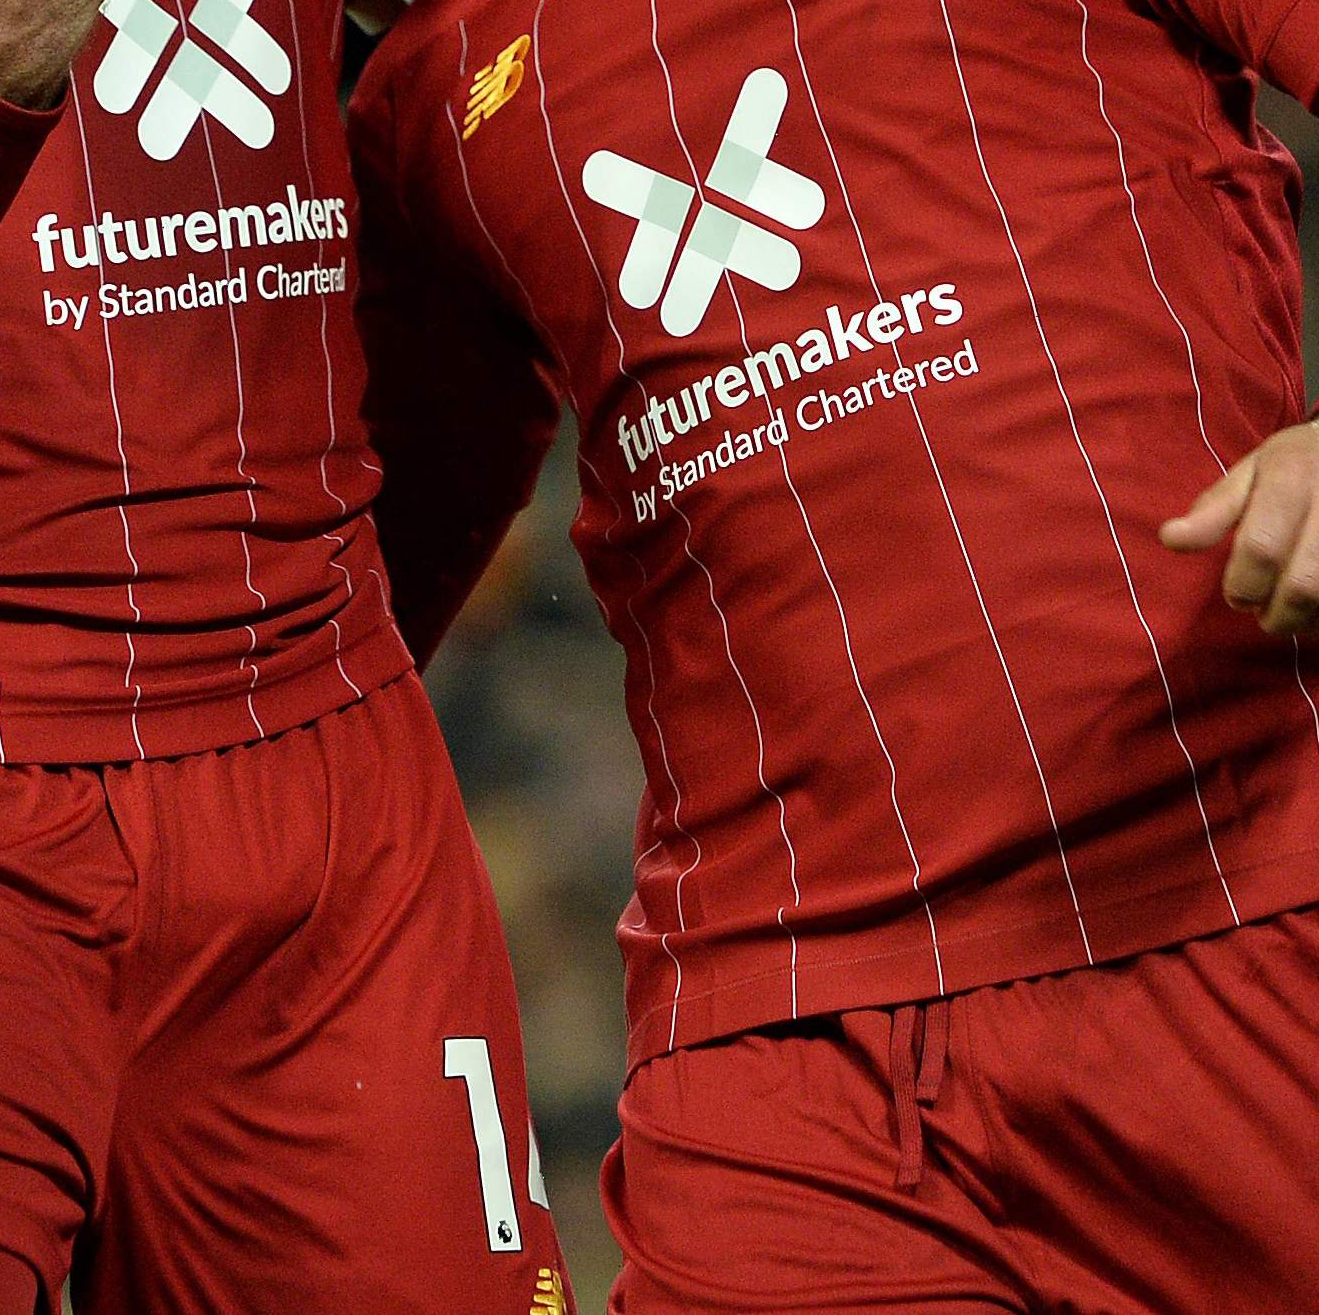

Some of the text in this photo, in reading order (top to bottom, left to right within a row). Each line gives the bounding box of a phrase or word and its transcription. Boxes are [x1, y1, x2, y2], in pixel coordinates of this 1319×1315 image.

[31, 185, 348, 272] futuremakers
[43, 290, 89, 331] by
[99, 267, 247, 319] Standard
[618, 283, 964, 472] futuremakers
[632, 338, 980, 523] by Standard Chartered
